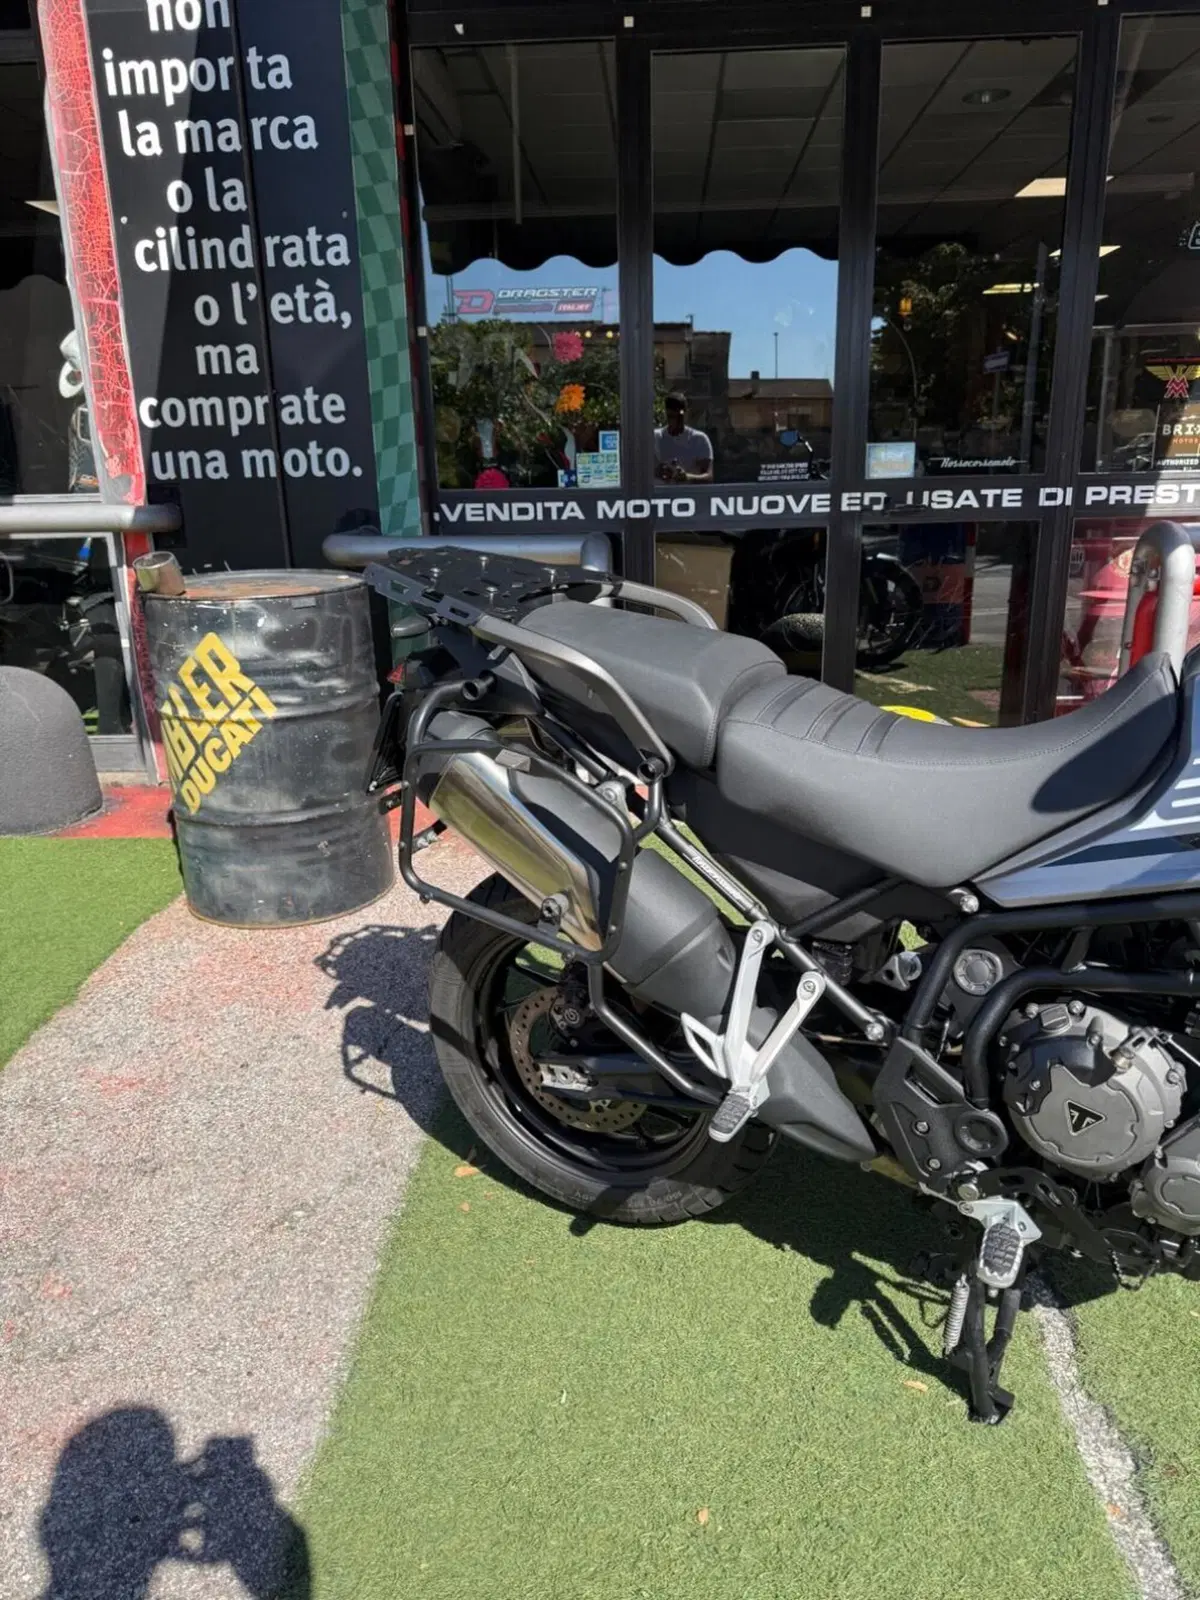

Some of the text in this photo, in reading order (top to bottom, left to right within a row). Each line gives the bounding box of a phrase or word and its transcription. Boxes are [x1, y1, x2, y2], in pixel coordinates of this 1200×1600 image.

[146, 0, 231, 32] non
[102, 46, 293, 106] importa
[118, 109, 318, 157] la marca
[166, 166, 248, 214] o la
[134, 223, 350, 273] cilindrata
[194, 294, 220, 326] o
[498, 287, 598, 298] DRAGSTER
[195, 342, 260, 376] ma
[138, 386, 346, 437] comprate
[151, 440, 364, 481] una moto.
[597, 498, 696, 519] MOTO
[710, 494, 831, 517] NUOVE
[1039, 487, 1073, 508] DI
[1085, 484, 1200, 506] PREST
[181, 685, 279, 814] DUCATI
